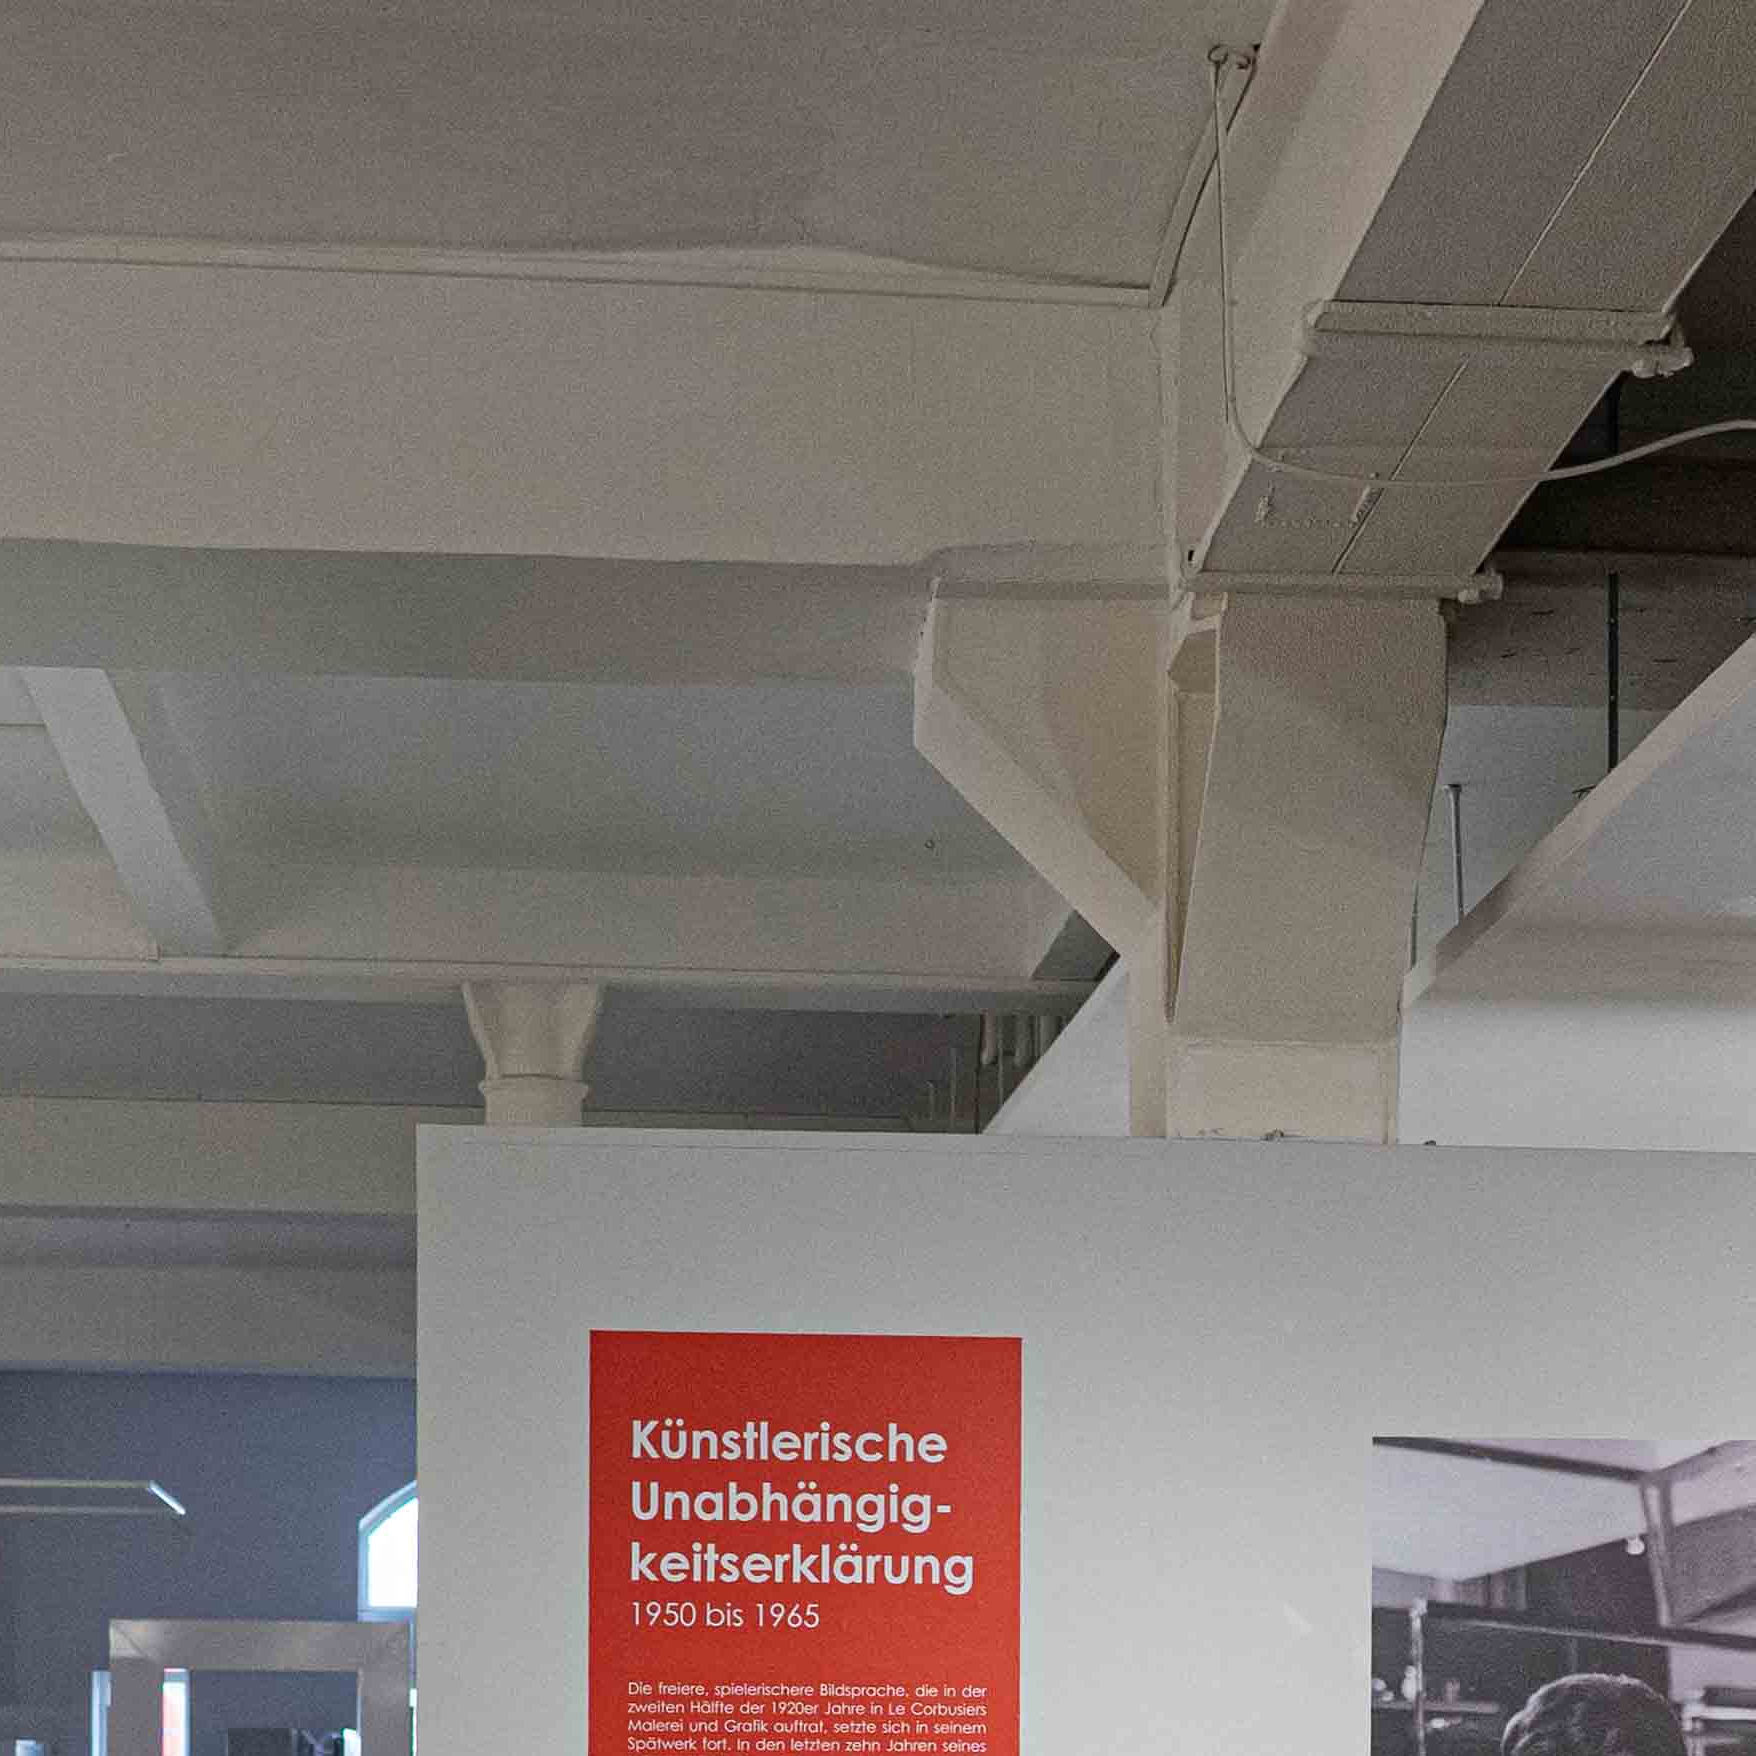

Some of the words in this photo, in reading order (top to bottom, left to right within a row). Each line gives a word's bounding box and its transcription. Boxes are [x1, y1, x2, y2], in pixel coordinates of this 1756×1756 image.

[631, 1418, 948, 1462] Künstlerische
[631, 1481, 952, 1533] Unabhängig-
[630, 1542, 974, 1595] keitserklärung
[632, 1602, 696, 1627] 1950
[706, 1602, 744, 1627] bis
[756, 1602, 820, 1628] 1965
[627, 1683, 653, 1696] Die
[657, 1683, 709, 1698] freiere,
[713, 1683, 815, 1699] spielerischere
[914, 1684, 939, 1697] die
[943, 1685, 957, 1698] in
[961, 1685, 988, 1698] der
[627, 1701, 685, 1715] zweiten
[689, 1702, 735, 1715] Hälfte
[739, 1702, 766, 1715] der
[771, 1702, 820, 1715] 1920er
[824, 1702, 866, 1715] Jahre
[870, 1702, 884, 1715] in
[888, 1703, 906, 1716] Le
[910, 1703, 988, 1716] Corbusiers
[627, 1720, 684, 1733] Malerei
[688, 1720, 719, 1733] und
[723, 1720, 769, 1733] Grafik
[772, 1720, 828, 1735] auftrat,
[833, 1721, 877, 1734] setzte
[881, 1721, 911, 1734] sich
[915, 1721, 929, 1734] in
[933, 1721, 987, 1734] seinem
[627, 1738, 698, 1754] Spätwerk
[702, 1738, 732, 1751] fort.
[736, 1738, 751, 1751] In
[755, 1738, 786, 1752] den
[790, 1739, 841, 1752] letzten
[844, 1739, 881, 1752] zehn
[885, 1739, 938, 1752] Jahren
[941, 1739, 988, 1753] seines
